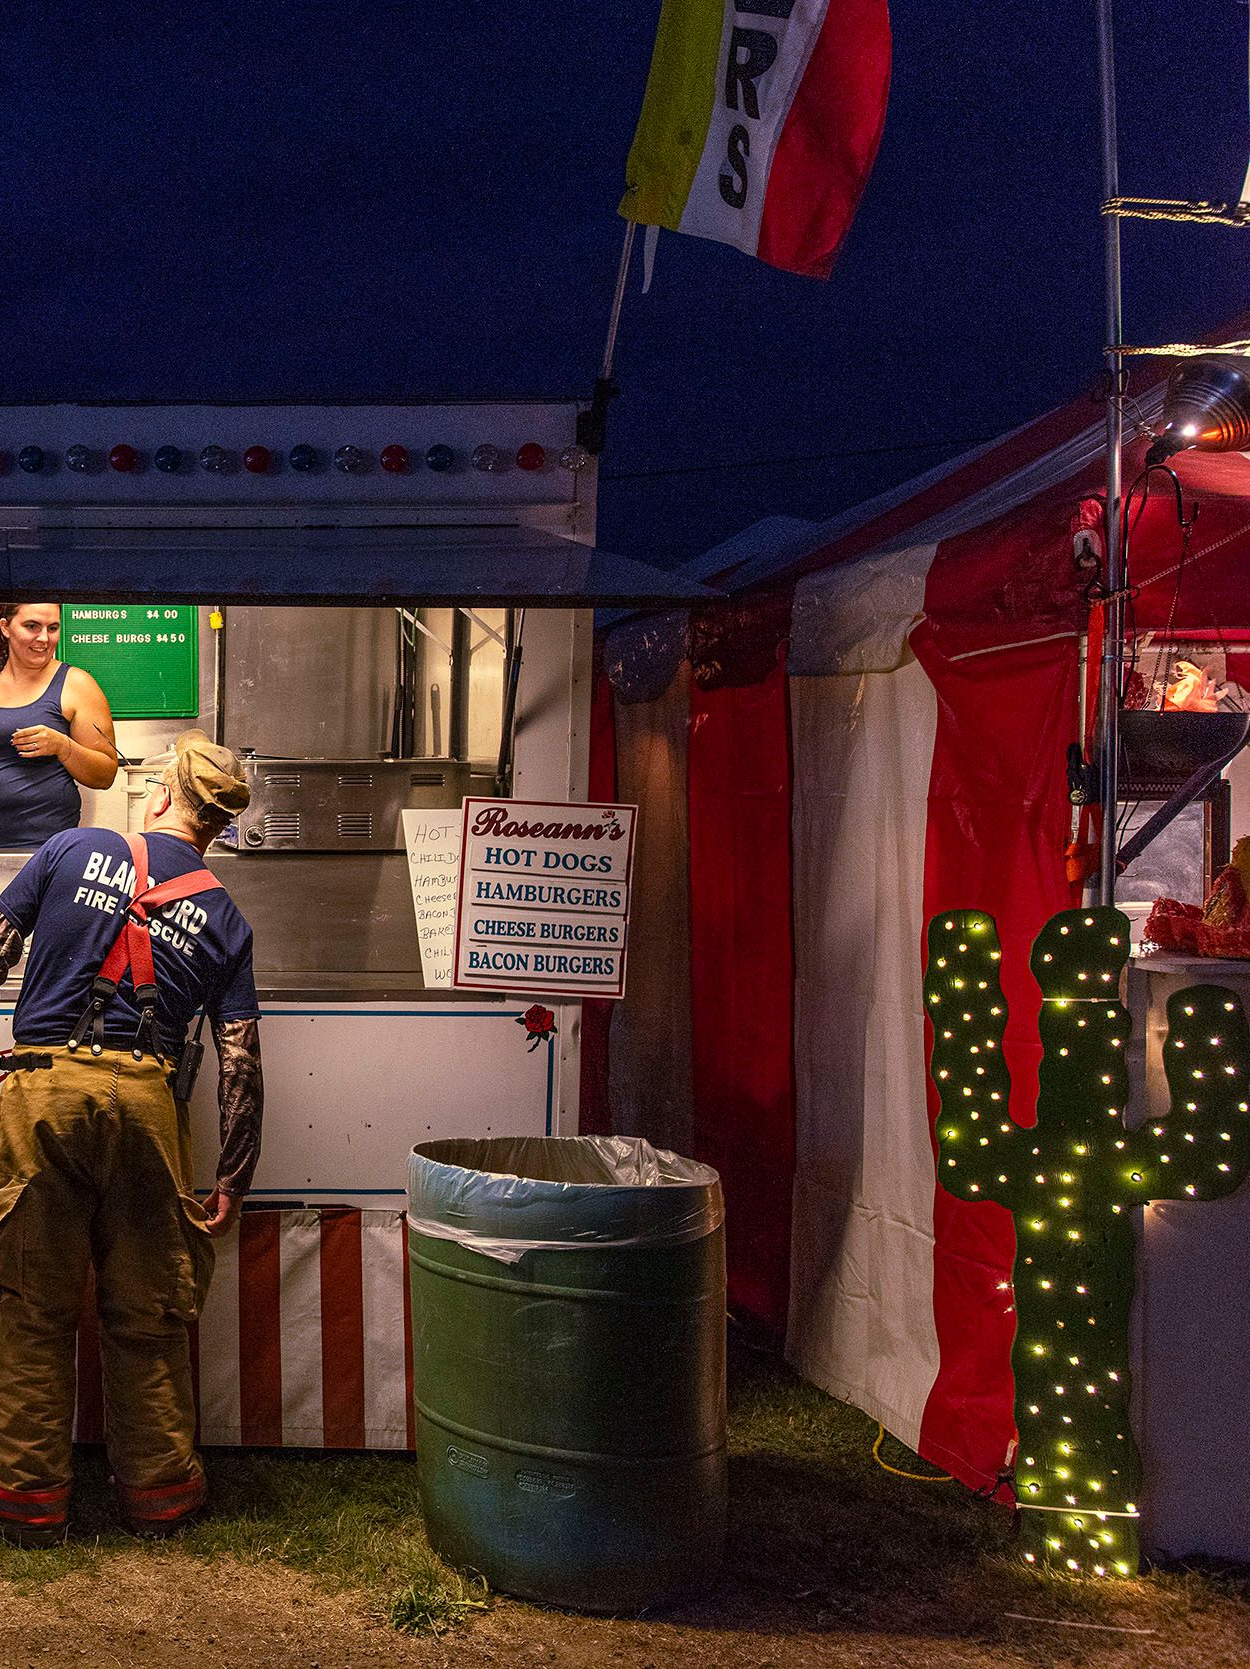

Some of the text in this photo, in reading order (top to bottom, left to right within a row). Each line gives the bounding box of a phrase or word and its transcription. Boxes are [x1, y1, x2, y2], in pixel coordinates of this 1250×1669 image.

[718, 0, 796, 209] RS
[72, 610, 178, 620] HAMBURGS $4 00
[71, 634, 110, 644] CHEESE
[116, 634, 152, 643] BURGS
[414, 824, 454, 844] HOT
[471, 807, 626, 841] Roseann's
[484, 847, 613, 873] HOT DOGS
[82, 851, 208, 935] BLANORD
[475, 881, 622, 908] HAMBURGERS
[73, 886, 198, 957] FIRE SCUE
[418, 909, 449, 921] BACON
[473, 919, 619, 943] CHEESE BURGERS
[468, 951, 615, 975] BACON BURGERS
